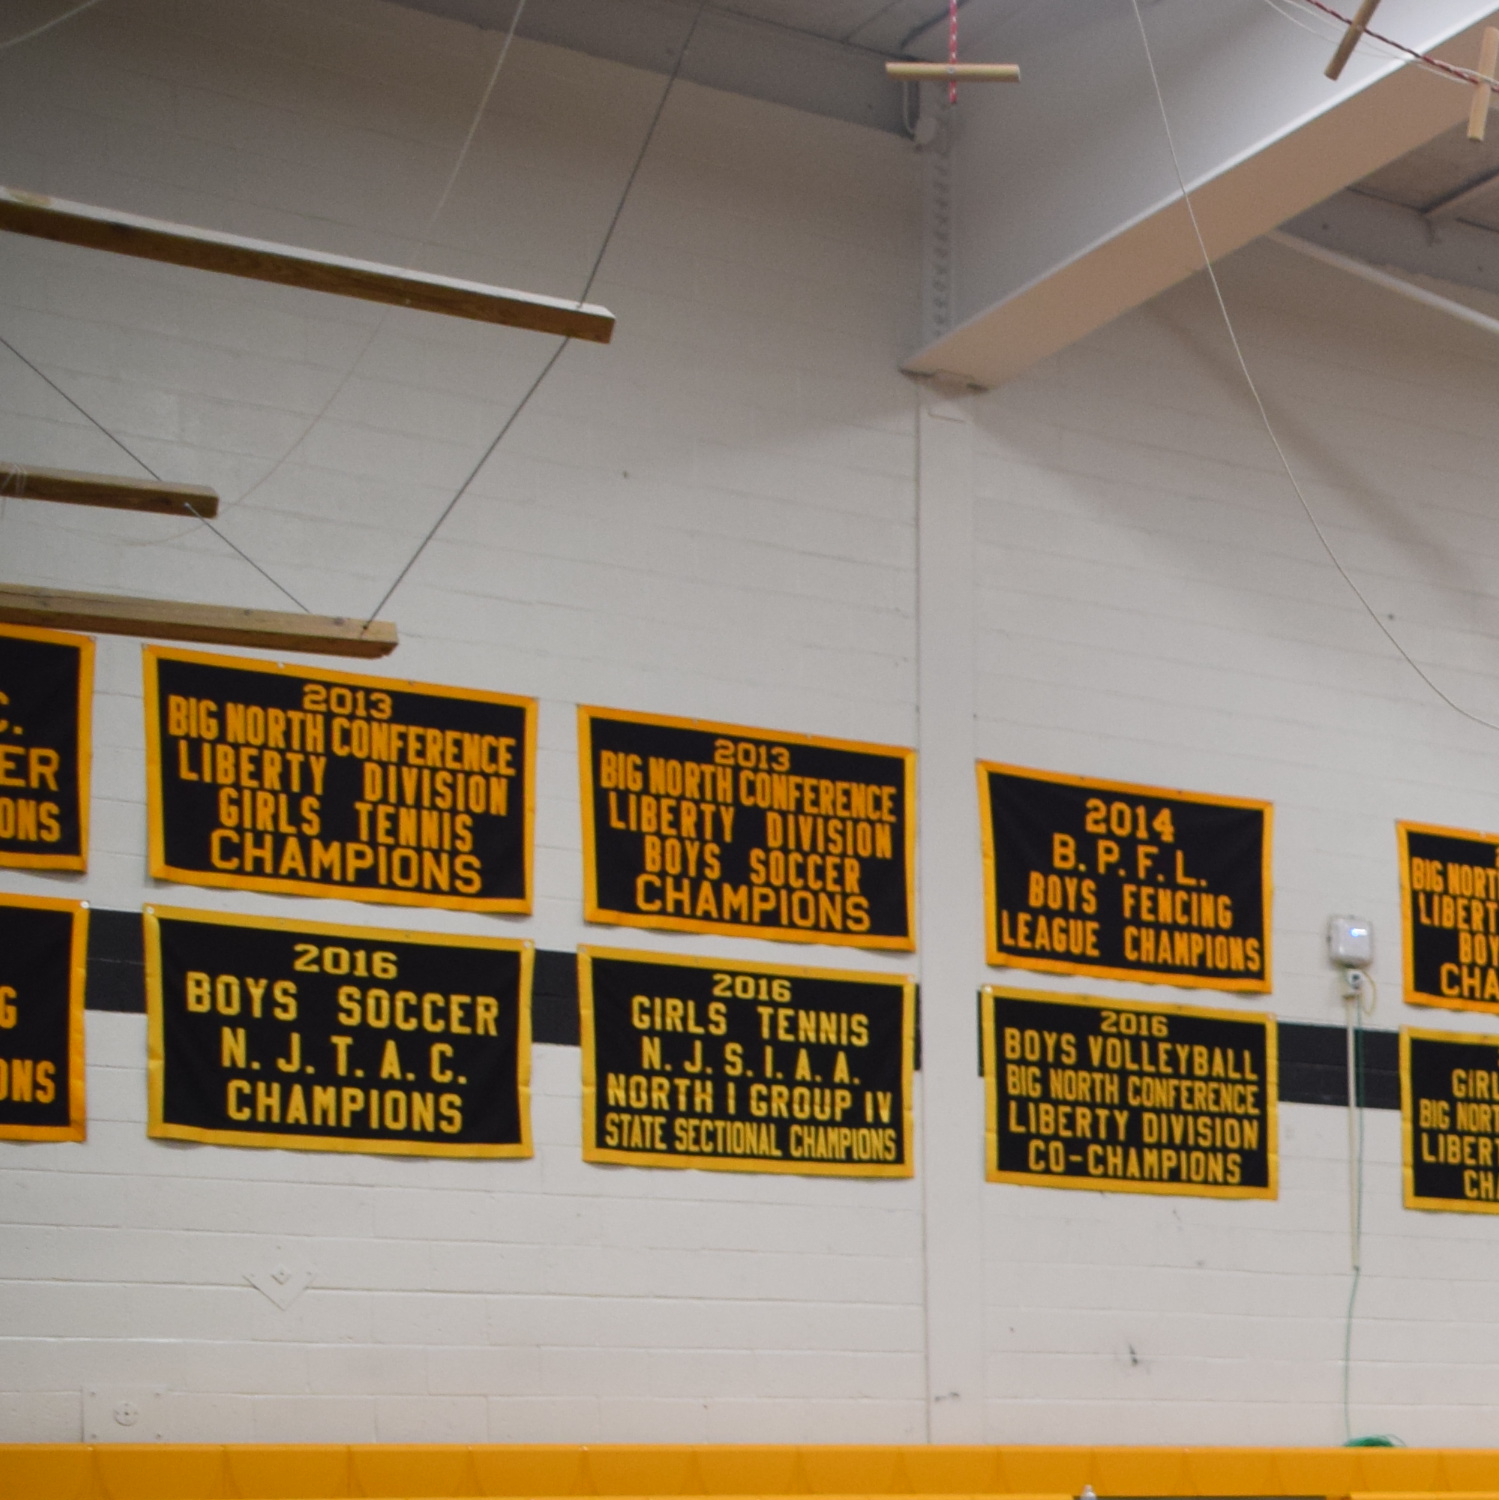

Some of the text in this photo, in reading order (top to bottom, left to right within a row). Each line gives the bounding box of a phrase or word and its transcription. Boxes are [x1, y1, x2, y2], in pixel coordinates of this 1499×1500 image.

[303, 683, 392, 718] 2013
[168, 695, 516, 776] BIG NORTH CONFERENCE
[713, 739, 790, 772] 2013
[179, 742, 508, 816] LIBERTY DIVISION
[600, 750, 896, 822] BIG NORTH CONFERENCE
[218, 788, 473, 852] GIRLS TENNIS
[609, 792, 891, 858] LIBERTY DIVISION
[1085, 798, 1174, 842] 2014
[210, 829, 482, 894] CHAMPIONS
[645, 835, 860, 894] BOYS SOCCER
[1412, 857, 1443, 892] BIG
[636, 874, 870, 932] CHAMPIONS
[1028, 871, 1233, 929] BOYS FENCING
[293, 944, 398, 979] 2016
[1002, 910, 1260, 972] LEAGUE CHAMPIONS
[186, 972, 498, 1036] BOYS SOCCER
[712, 974, 792, 1001] 2016
[632, 996, 869, 1046] GIRLS TENNIS
[1100, 1011, 1168, 1037] 2016
[1004, 1027, 1257, 1080] BOYS VOLLEYBALL
[226, 1081, 463, 1134] CHAMPIONS
[607, 1073, 713, 1113] NORTH
[750, 1084, 852, 1122] GROUP
[865, 1092, 892, 1123] IV
[1007, 1065, 1260, 1115] BIG NORTH CONFERENCE
[1420, 1099, 1450, 1130] BIG
[605, 1113, 896, 1161] STATE SECTIONAL CHAMPIONS
[1009, 1100, 1258, 1150] LIBERTY DIVISION
[1028, 1140, 1242, 1184] CO-CHAMPIONS
